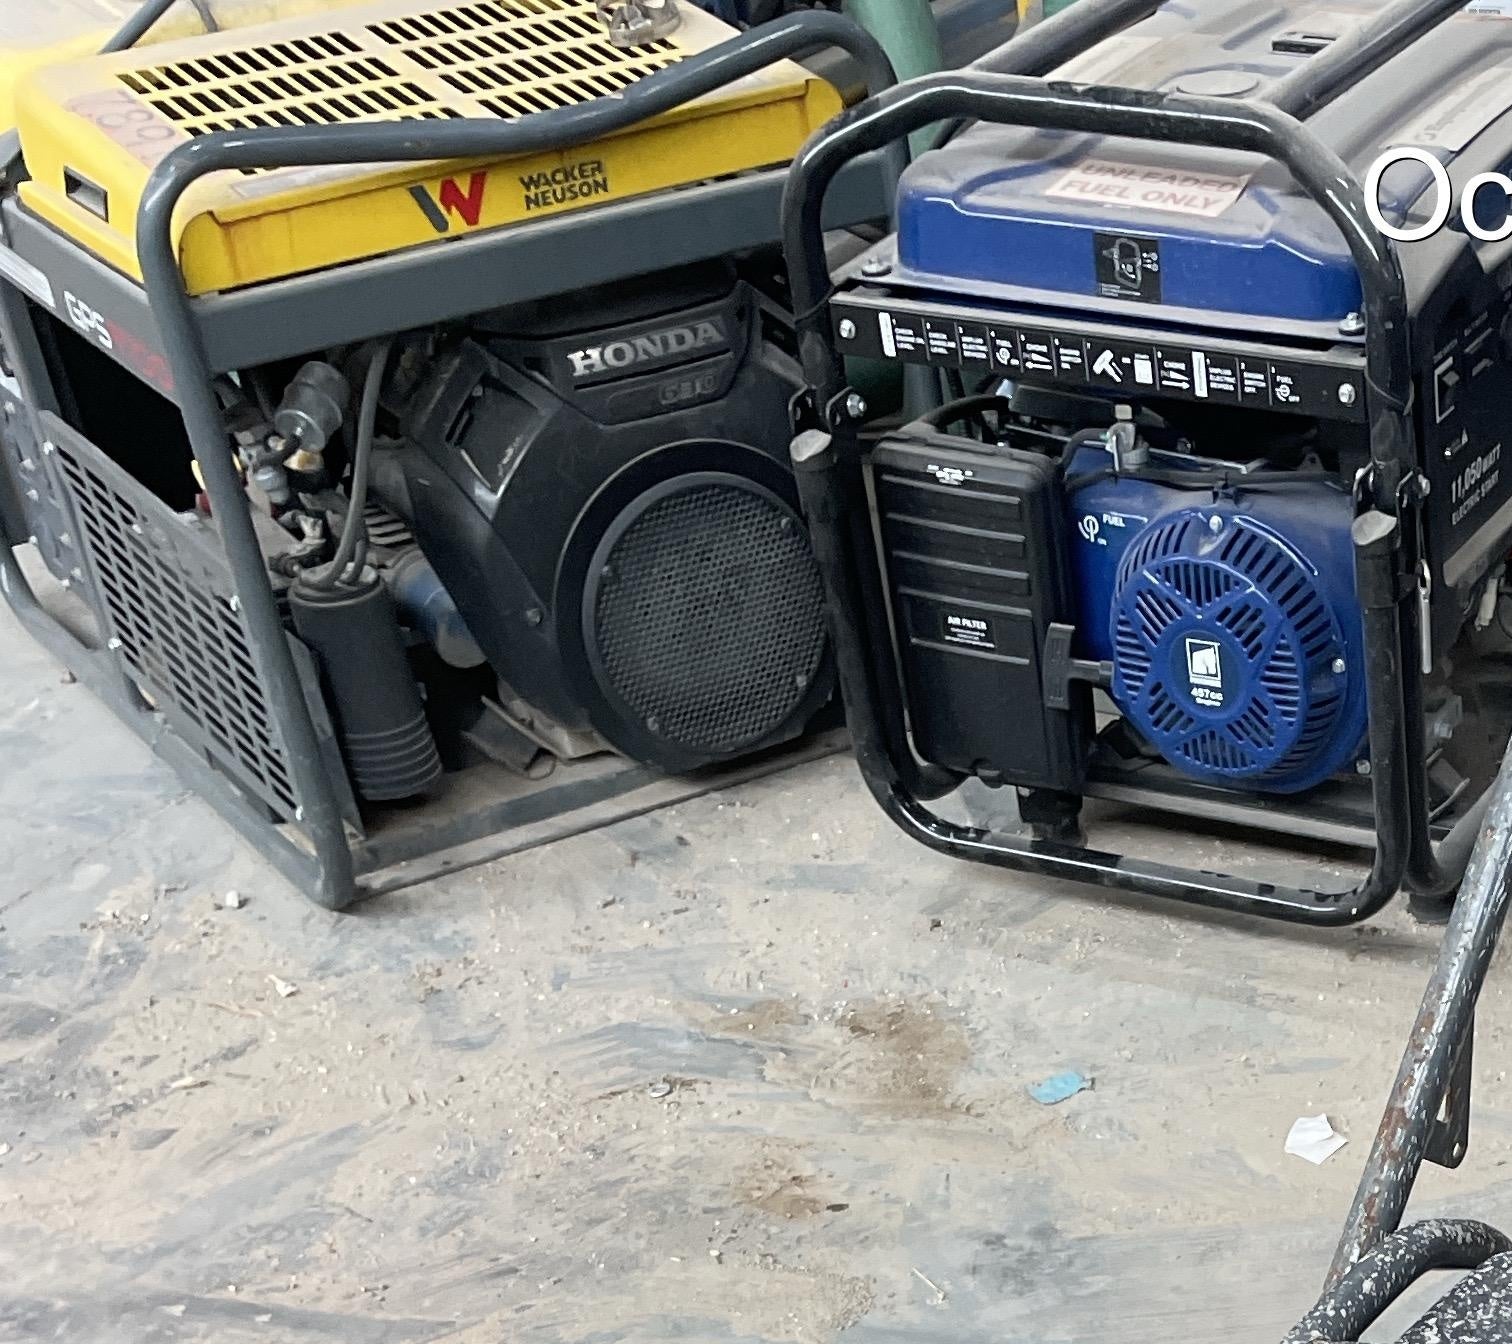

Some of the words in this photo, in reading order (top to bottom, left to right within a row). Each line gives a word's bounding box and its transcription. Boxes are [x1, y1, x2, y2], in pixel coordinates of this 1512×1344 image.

[519, 160, 604, 192] WACKER
[1081, 164, 1239, 193] UNLEADED
[524, 177, 609, 211] NEUSON
[1060, 179, 1131, 199] FUEL
[1142, 189, 1221, 210] ONLY
[63, 290, 113, 349] GPS
[567, 320, 725, 377] HONDA
